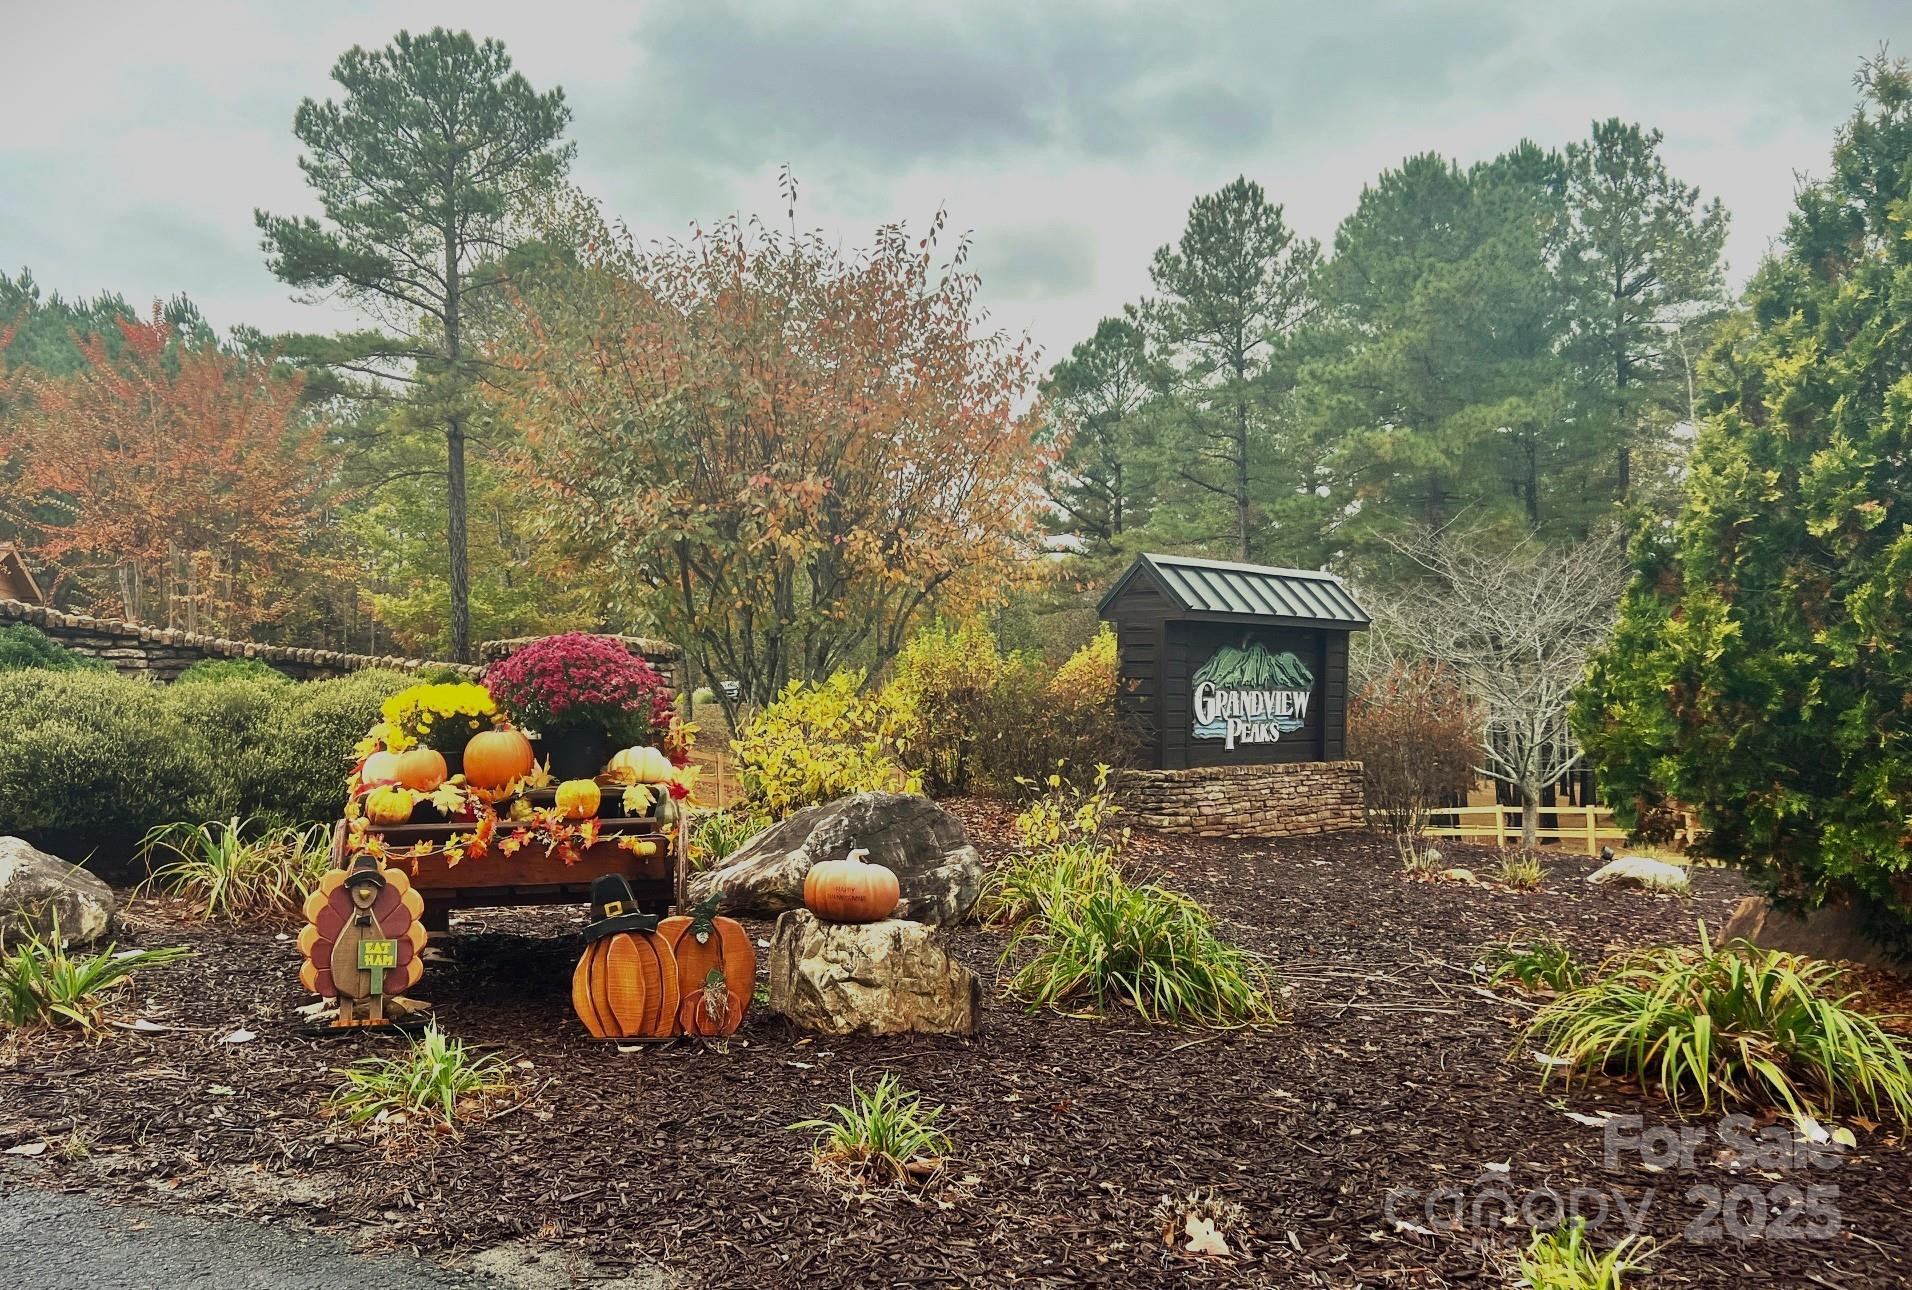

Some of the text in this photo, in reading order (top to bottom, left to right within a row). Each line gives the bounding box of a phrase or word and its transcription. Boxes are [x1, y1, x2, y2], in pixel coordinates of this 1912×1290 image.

[1194, 681, 1310, 725] GRANDVIEW
[1225, 717, 1280, 751] PEAKS
[365, 942, 391, 954] EAT
[364, 954, 394, 966] HAM
